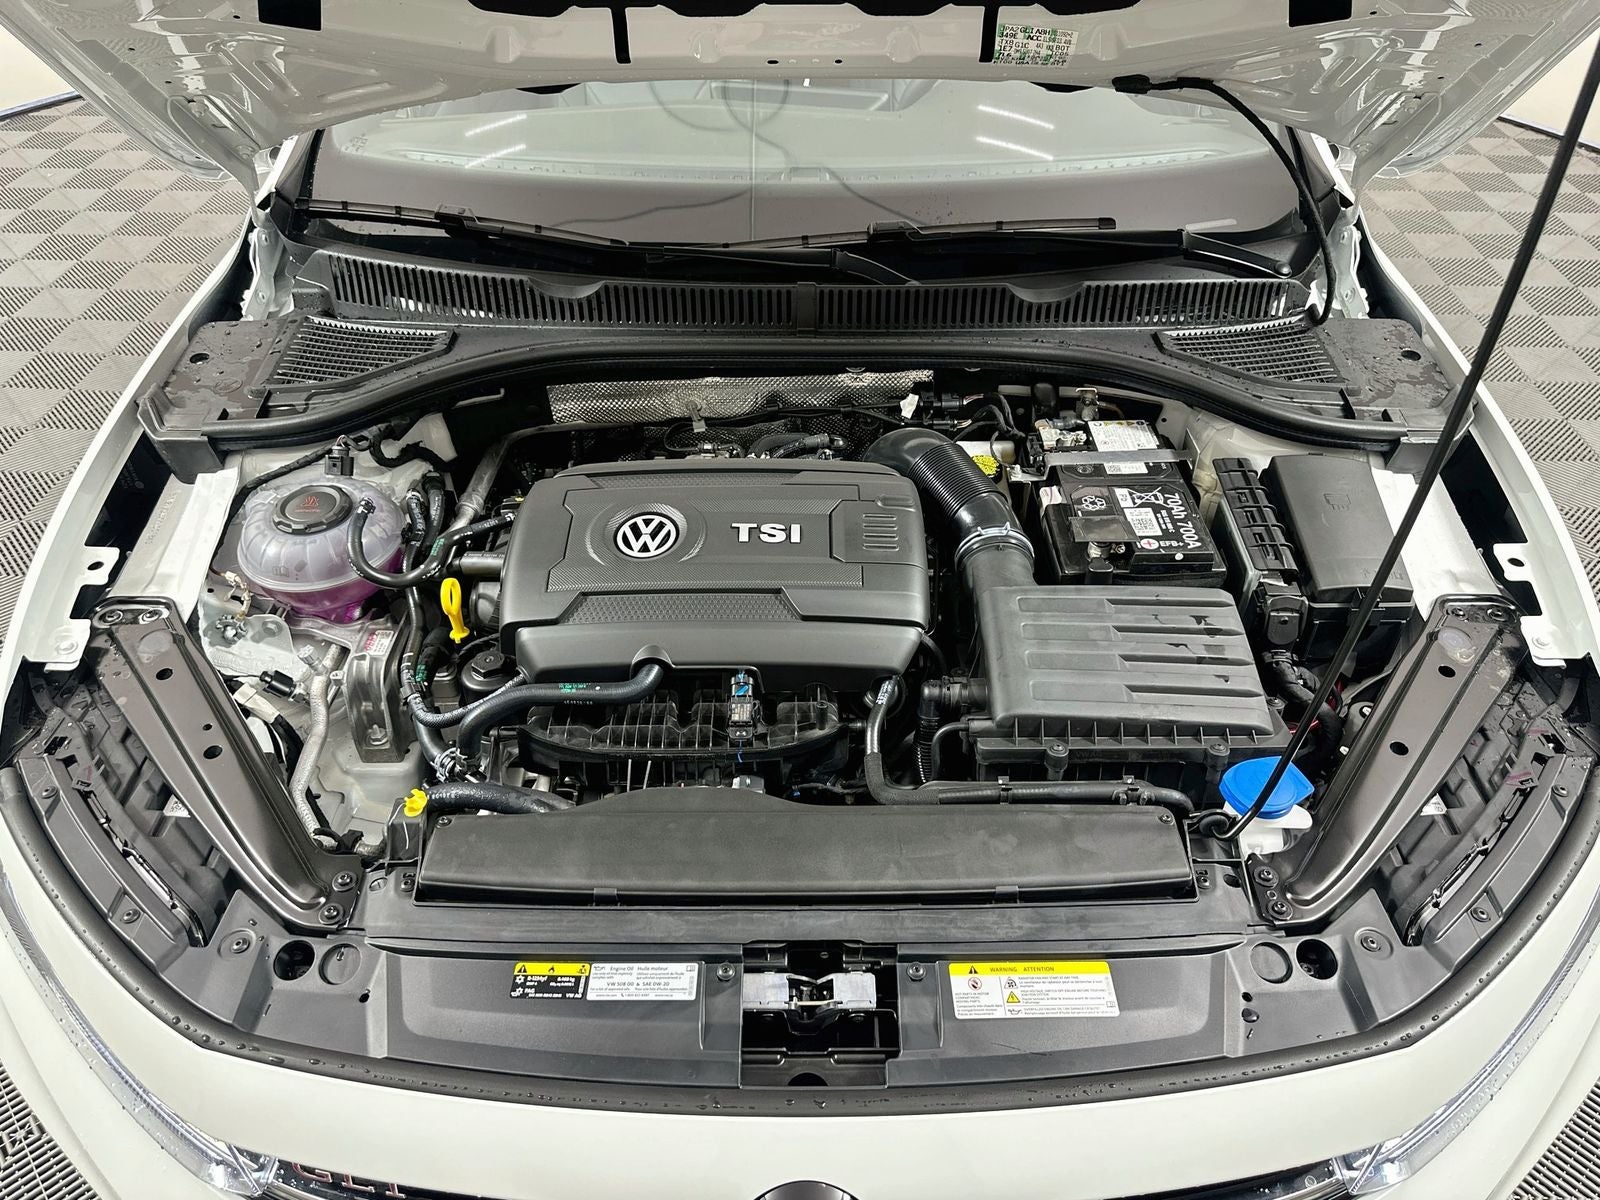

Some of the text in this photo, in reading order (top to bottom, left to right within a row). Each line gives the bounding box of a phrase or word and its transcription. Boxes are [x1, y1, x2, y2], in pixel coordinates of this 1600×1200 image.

[731, 522, 802, 544] TSI
[1164, 492, 1188, 519] 70Ah
[1176, 520, 1202, 549] 700A
